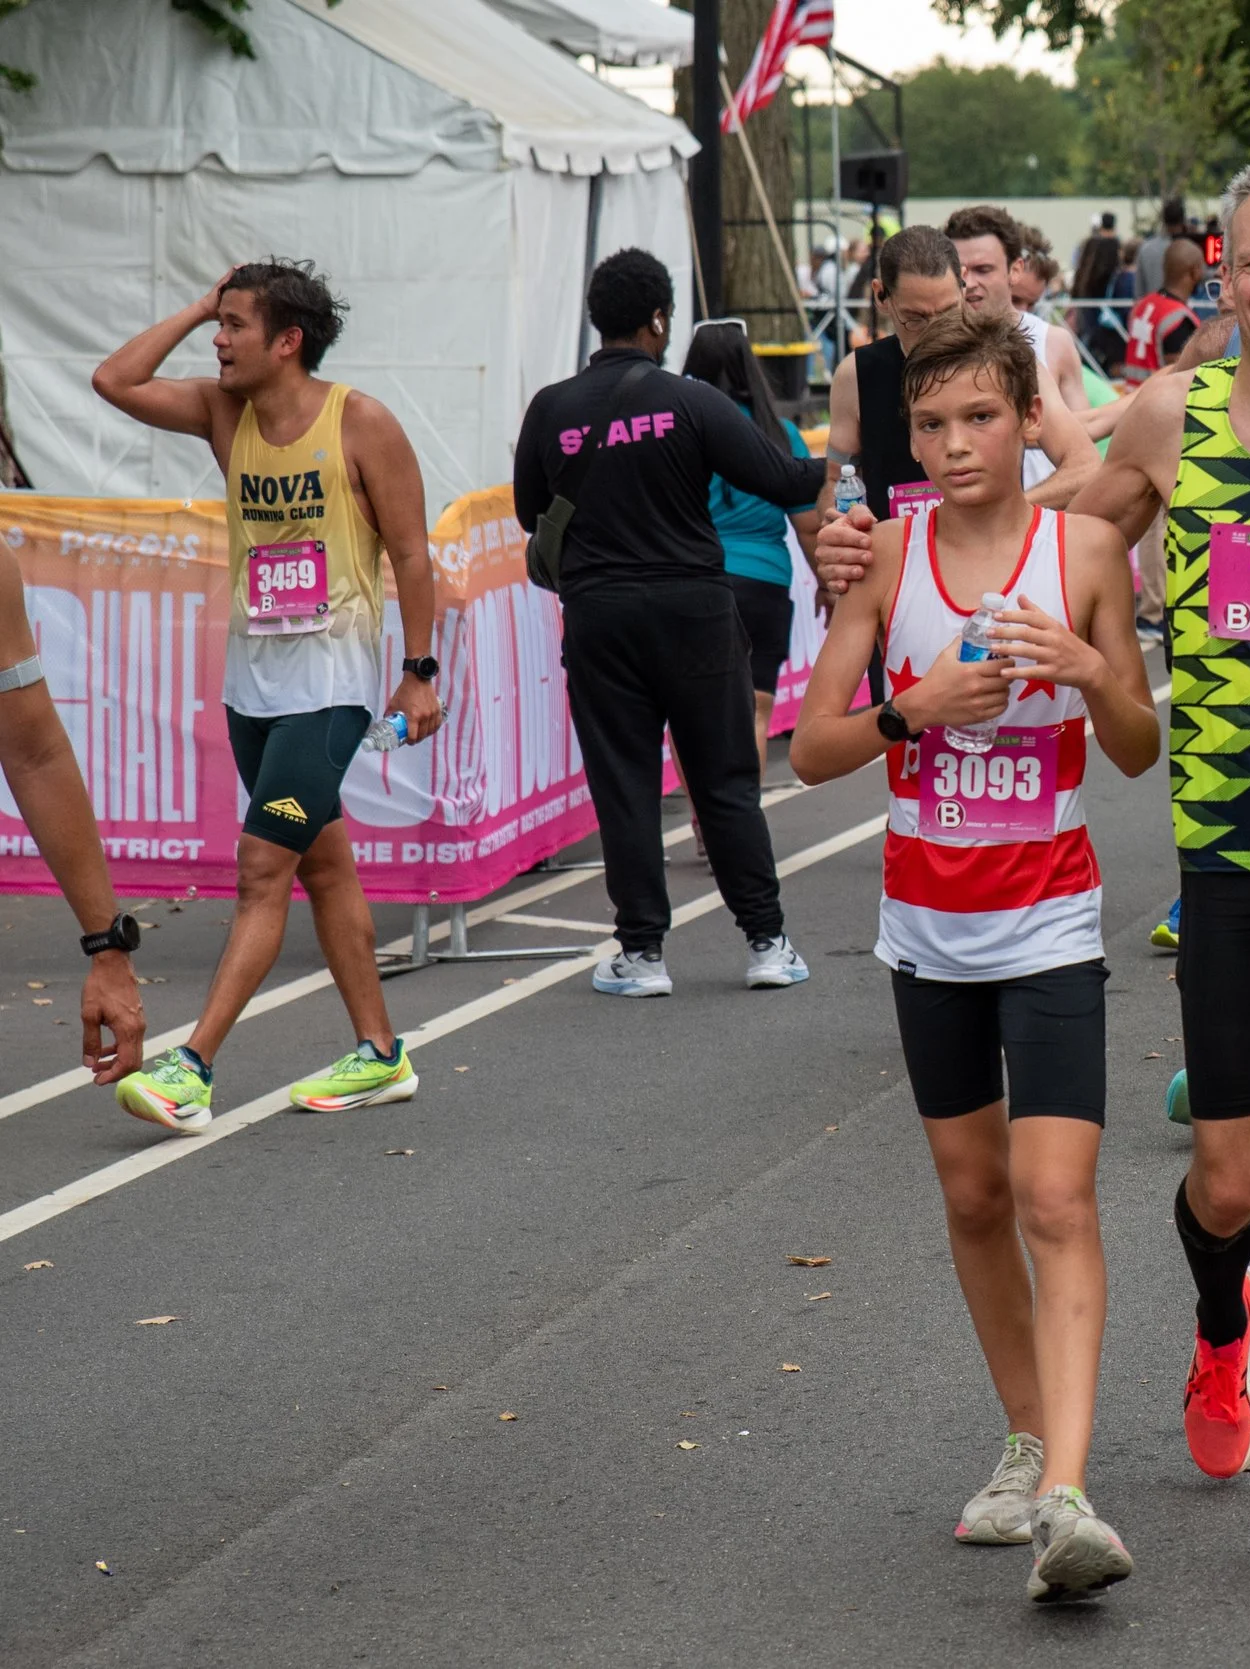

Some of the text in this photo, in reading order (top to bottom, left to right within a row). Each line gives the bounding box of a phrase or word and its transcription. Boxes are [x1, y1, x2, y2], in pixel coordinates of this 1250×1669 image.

[559, 412, 674, 455] SAFF
[240, 470, 324, 505] NOVA
[242, 506, 324, 522] RUNNING CLUB
[257, 559, 316, 593] 3459
[1227, 603, 1248, 629] B
[91, 590, 206, 823] HALF
[933, 753, 1041, 801] 3093
[940, 802, 961, 827] B
[0, 835, 205, 861] HE TRICT
[352, 841, 393, 863] HE
